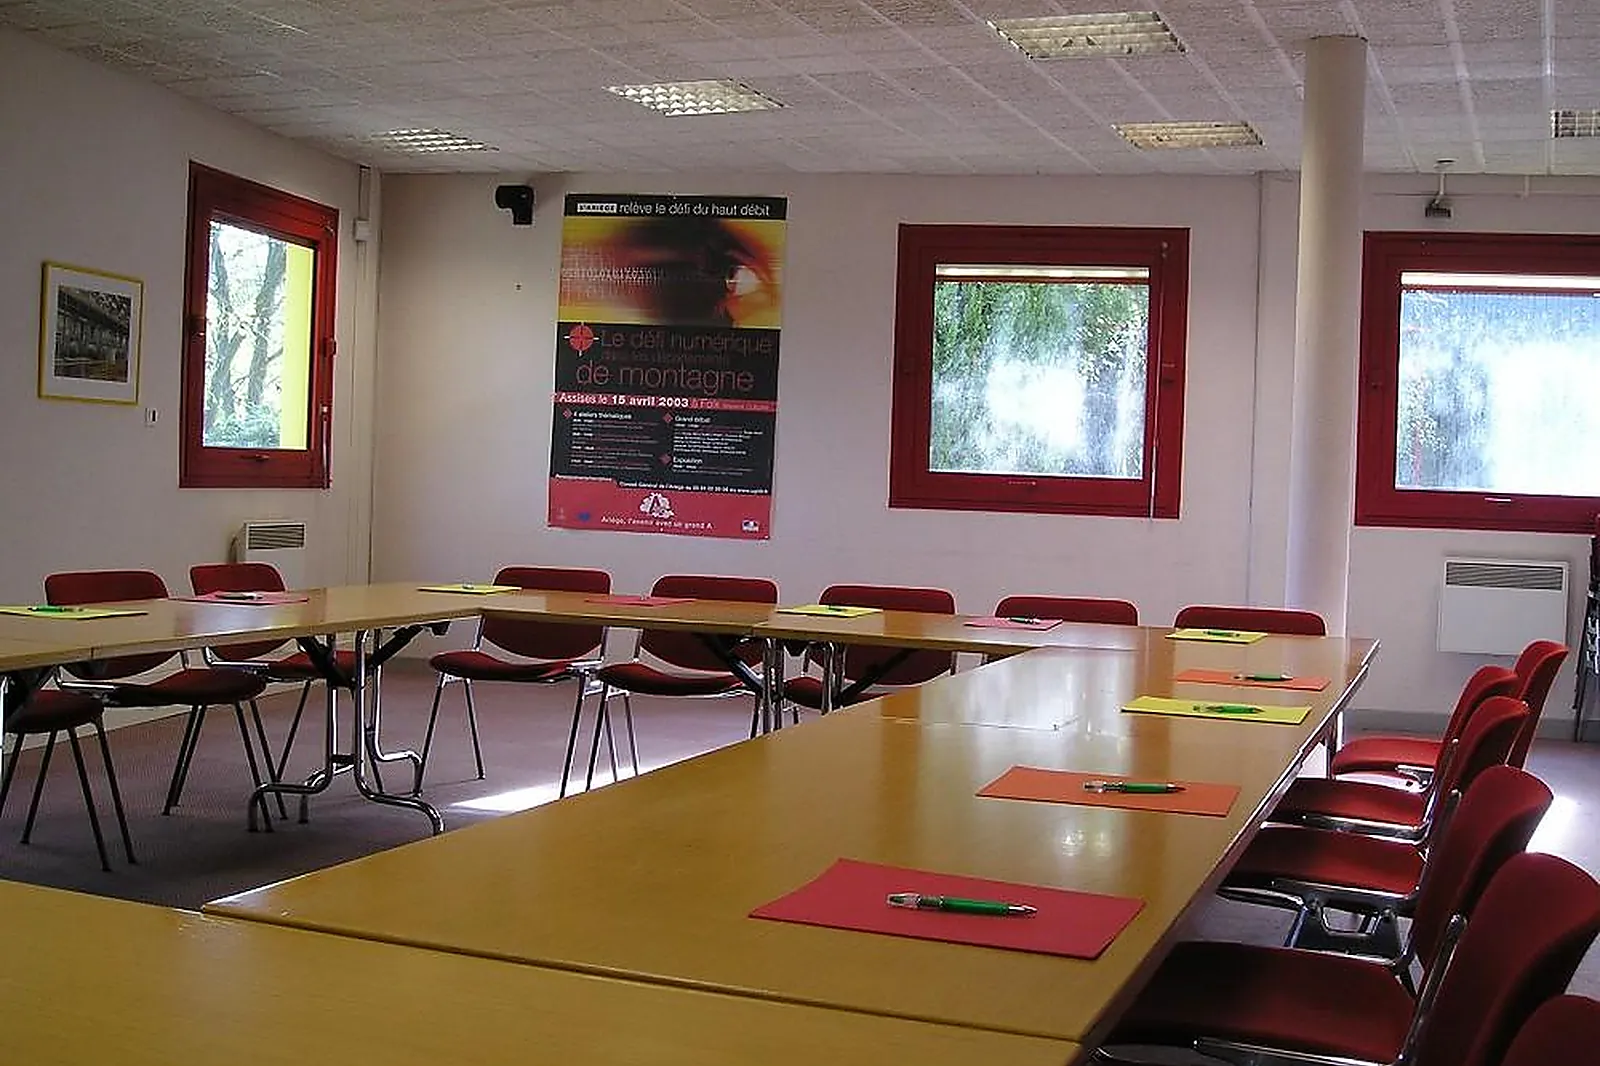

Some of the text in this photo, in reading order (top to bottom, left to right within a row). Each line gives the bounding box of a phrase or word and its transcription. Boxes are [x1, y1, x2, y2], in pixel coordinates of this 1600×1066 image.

[619, 201, 652, 214] relève
[655, 202, 665, 213] le
[668, 202, 691, 215] défi
[693, 203, 709, 216] du
[711, 203, 738, 216] haut
[740, 203, 771, 217] débit
[601, 330, 773, 357] Le défi numérique
[575, 360, 755, 396] de montagne
[559, 392, 596, 404] Assises
[598, 394, 608, 405] le
[612, 395, 626, 405] 15
[629, 395, 656, 407] avril
[658, 396, 689, 408] 2003
